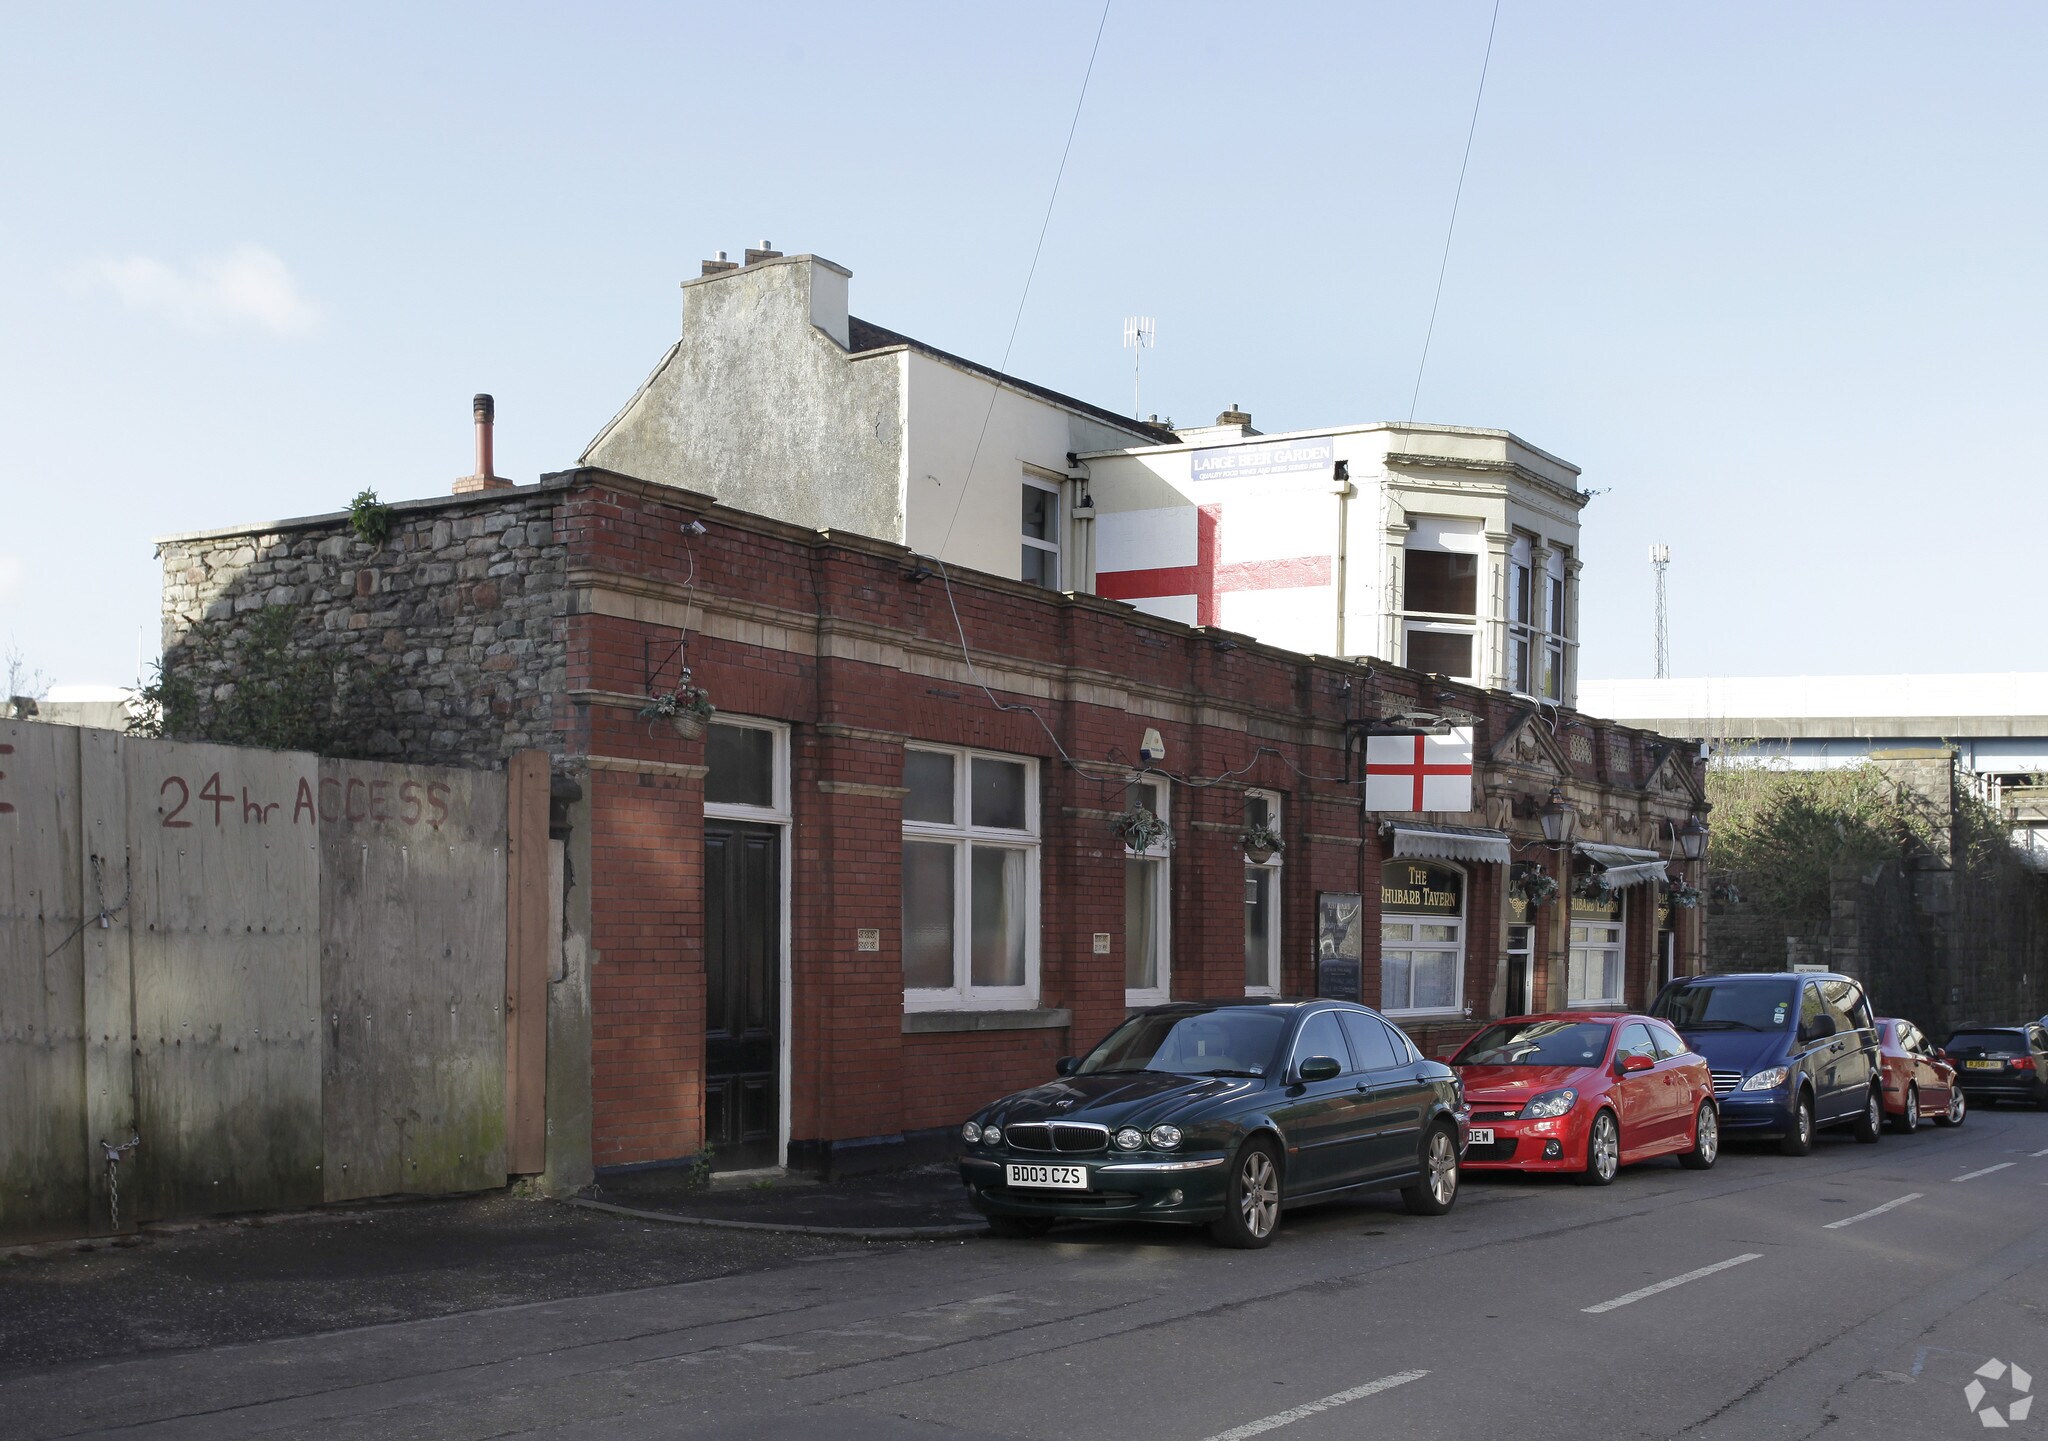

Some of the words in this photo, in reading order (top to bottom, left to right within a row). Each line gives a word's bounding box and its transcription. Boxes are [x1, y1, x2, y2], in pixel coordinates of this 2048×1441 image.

[1194, 456, 1236, 471] LARGE
[1238, 453, 1272, 467] BEER
[1274, 446, 1330, 463] GARDEN
[1199, 471, 1223, 480] QUALITY
[1222, 470, 1239, 478] FOOD
[292, 776, 452, 827] ACCESS
[1408, 866, 1427, 885] THE
[1423, 887, 1456, 907] TAVERN
[1012, 1166, 1047, 1182] BD03
[1051, 1168, 1080, 1184] CZS
